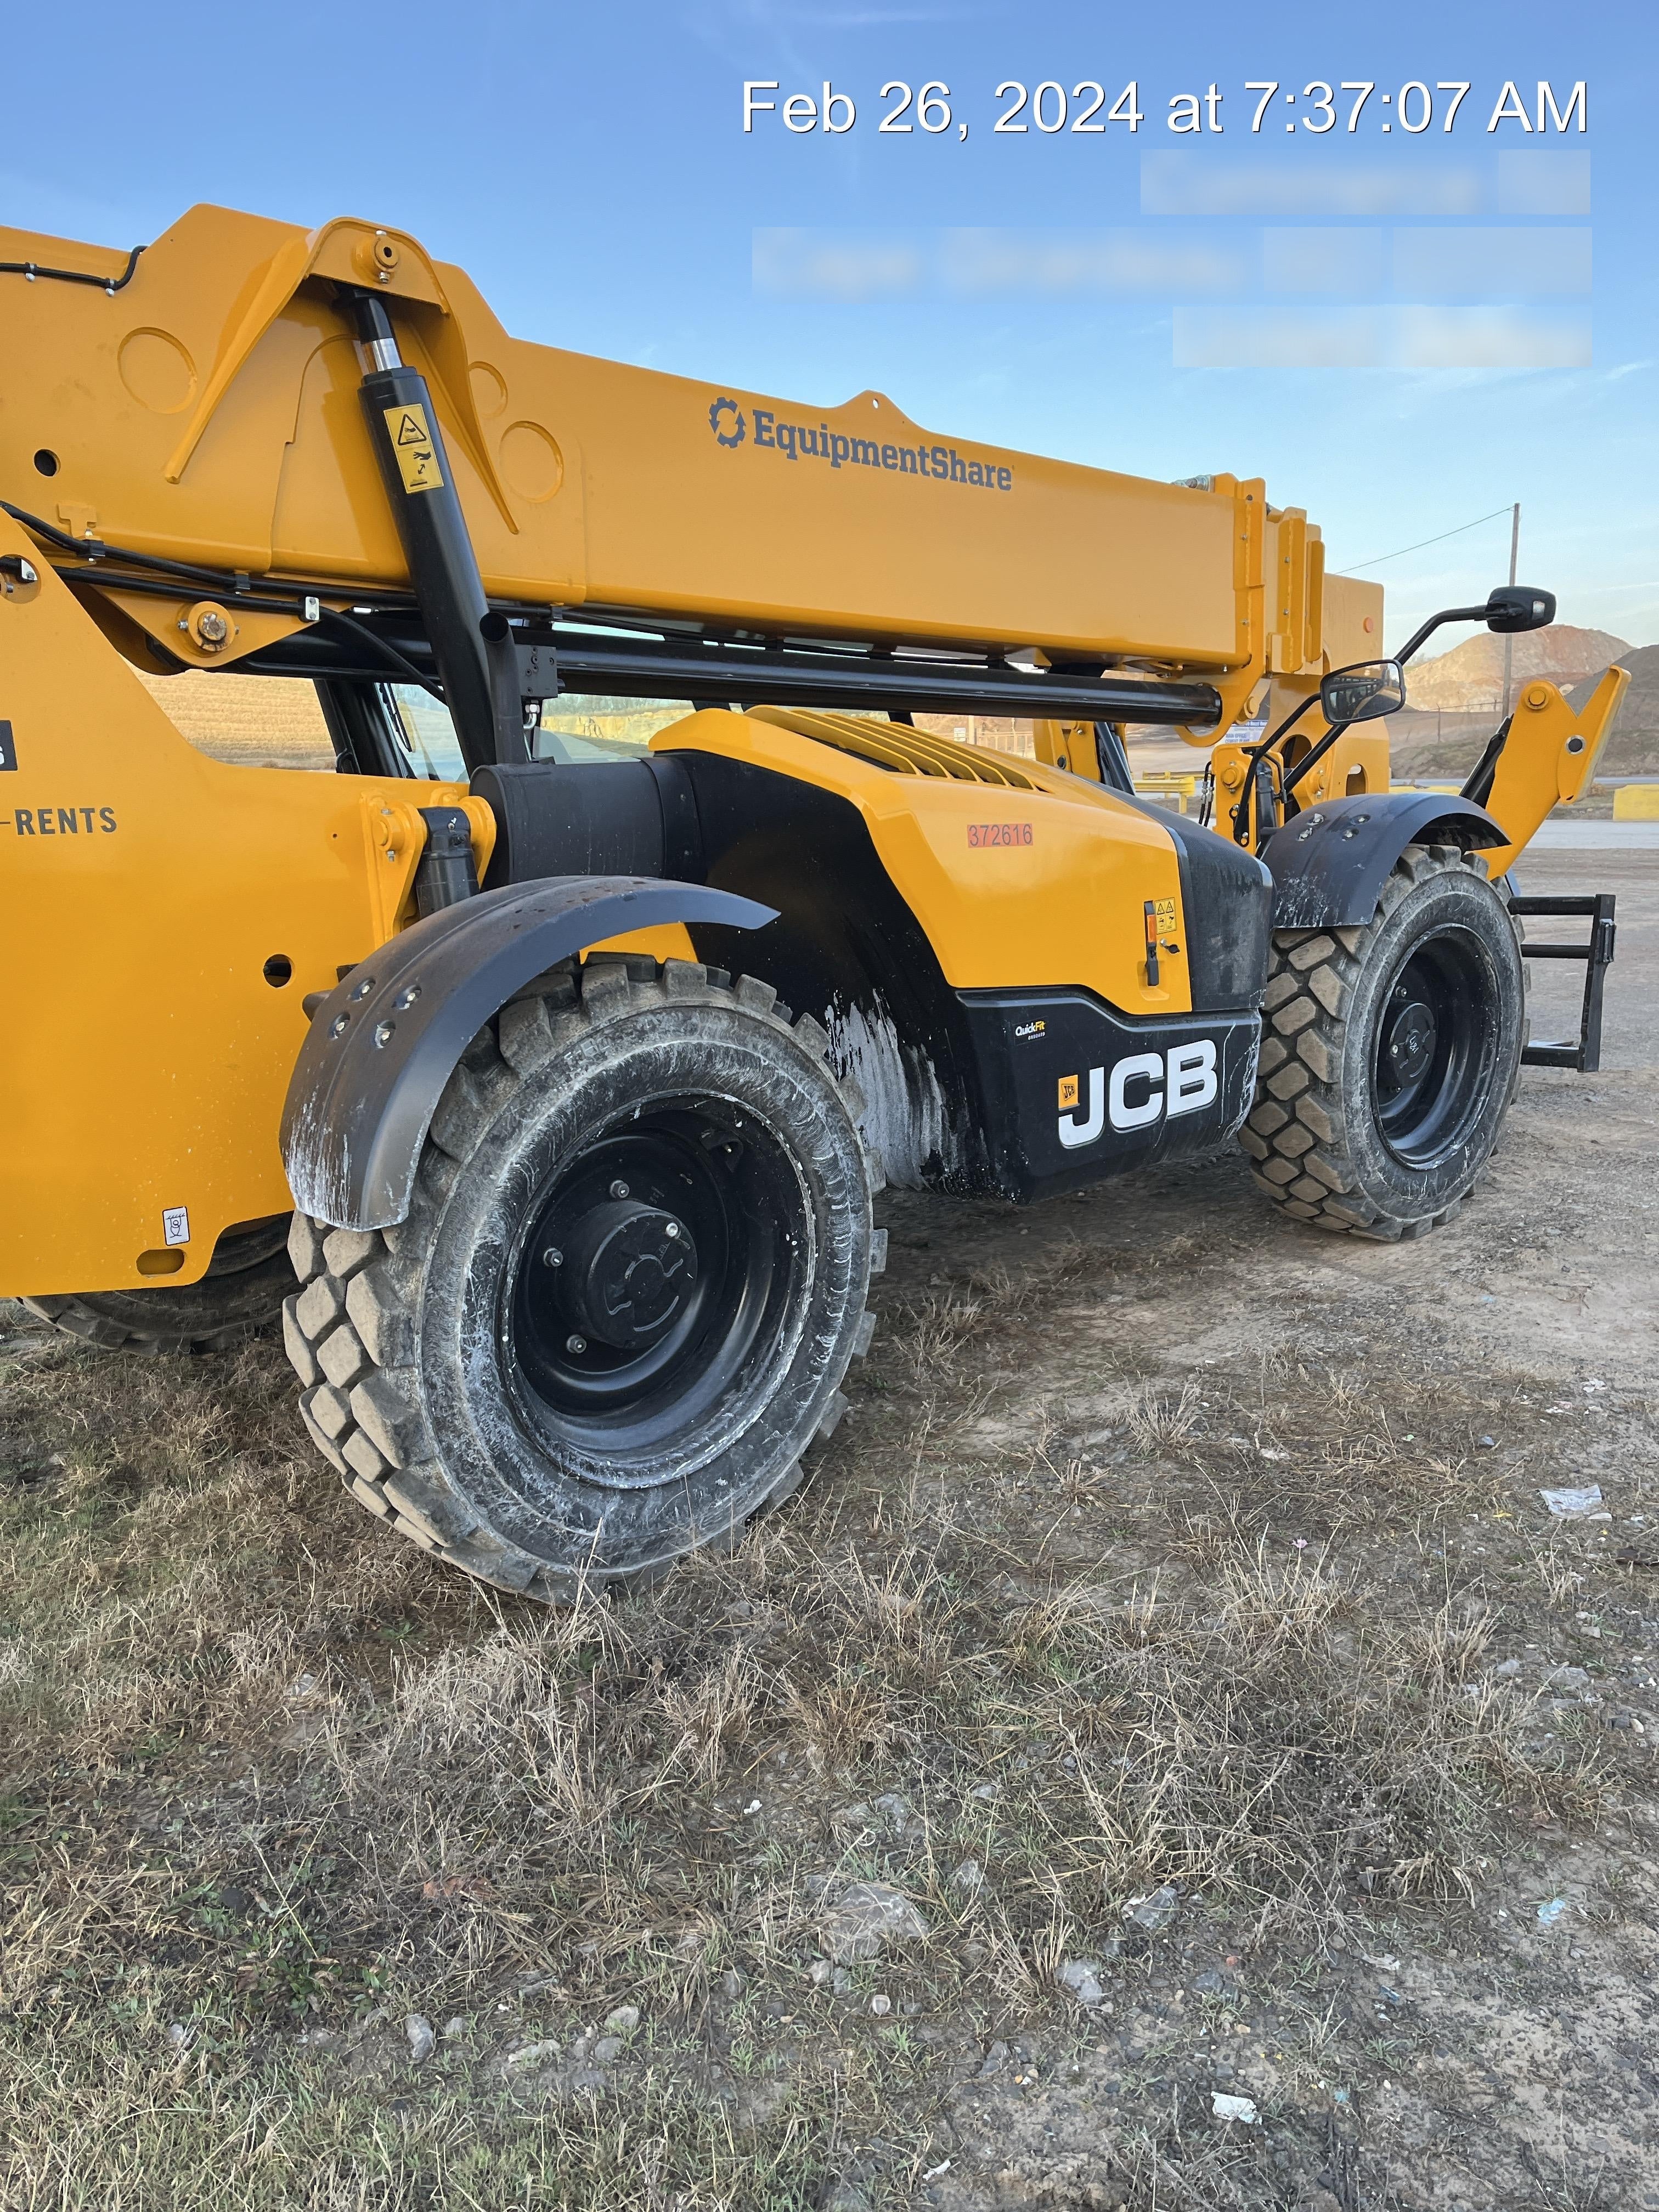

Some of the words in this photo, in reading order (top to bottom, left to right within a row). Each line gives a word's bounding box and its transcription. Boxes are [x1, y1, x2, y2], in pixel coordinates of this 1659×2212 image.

[752, 409, 1012, 492] EquipmentShare
[14, 807, 117, 836] RENTS
[969, 823, 1032, 847] 372616
[1015, 1020, 1046, 1036] QuickFit
[1058, 1039, 1218, 1147] JCB
[1063, 1085, 1075, 1099] JCB
